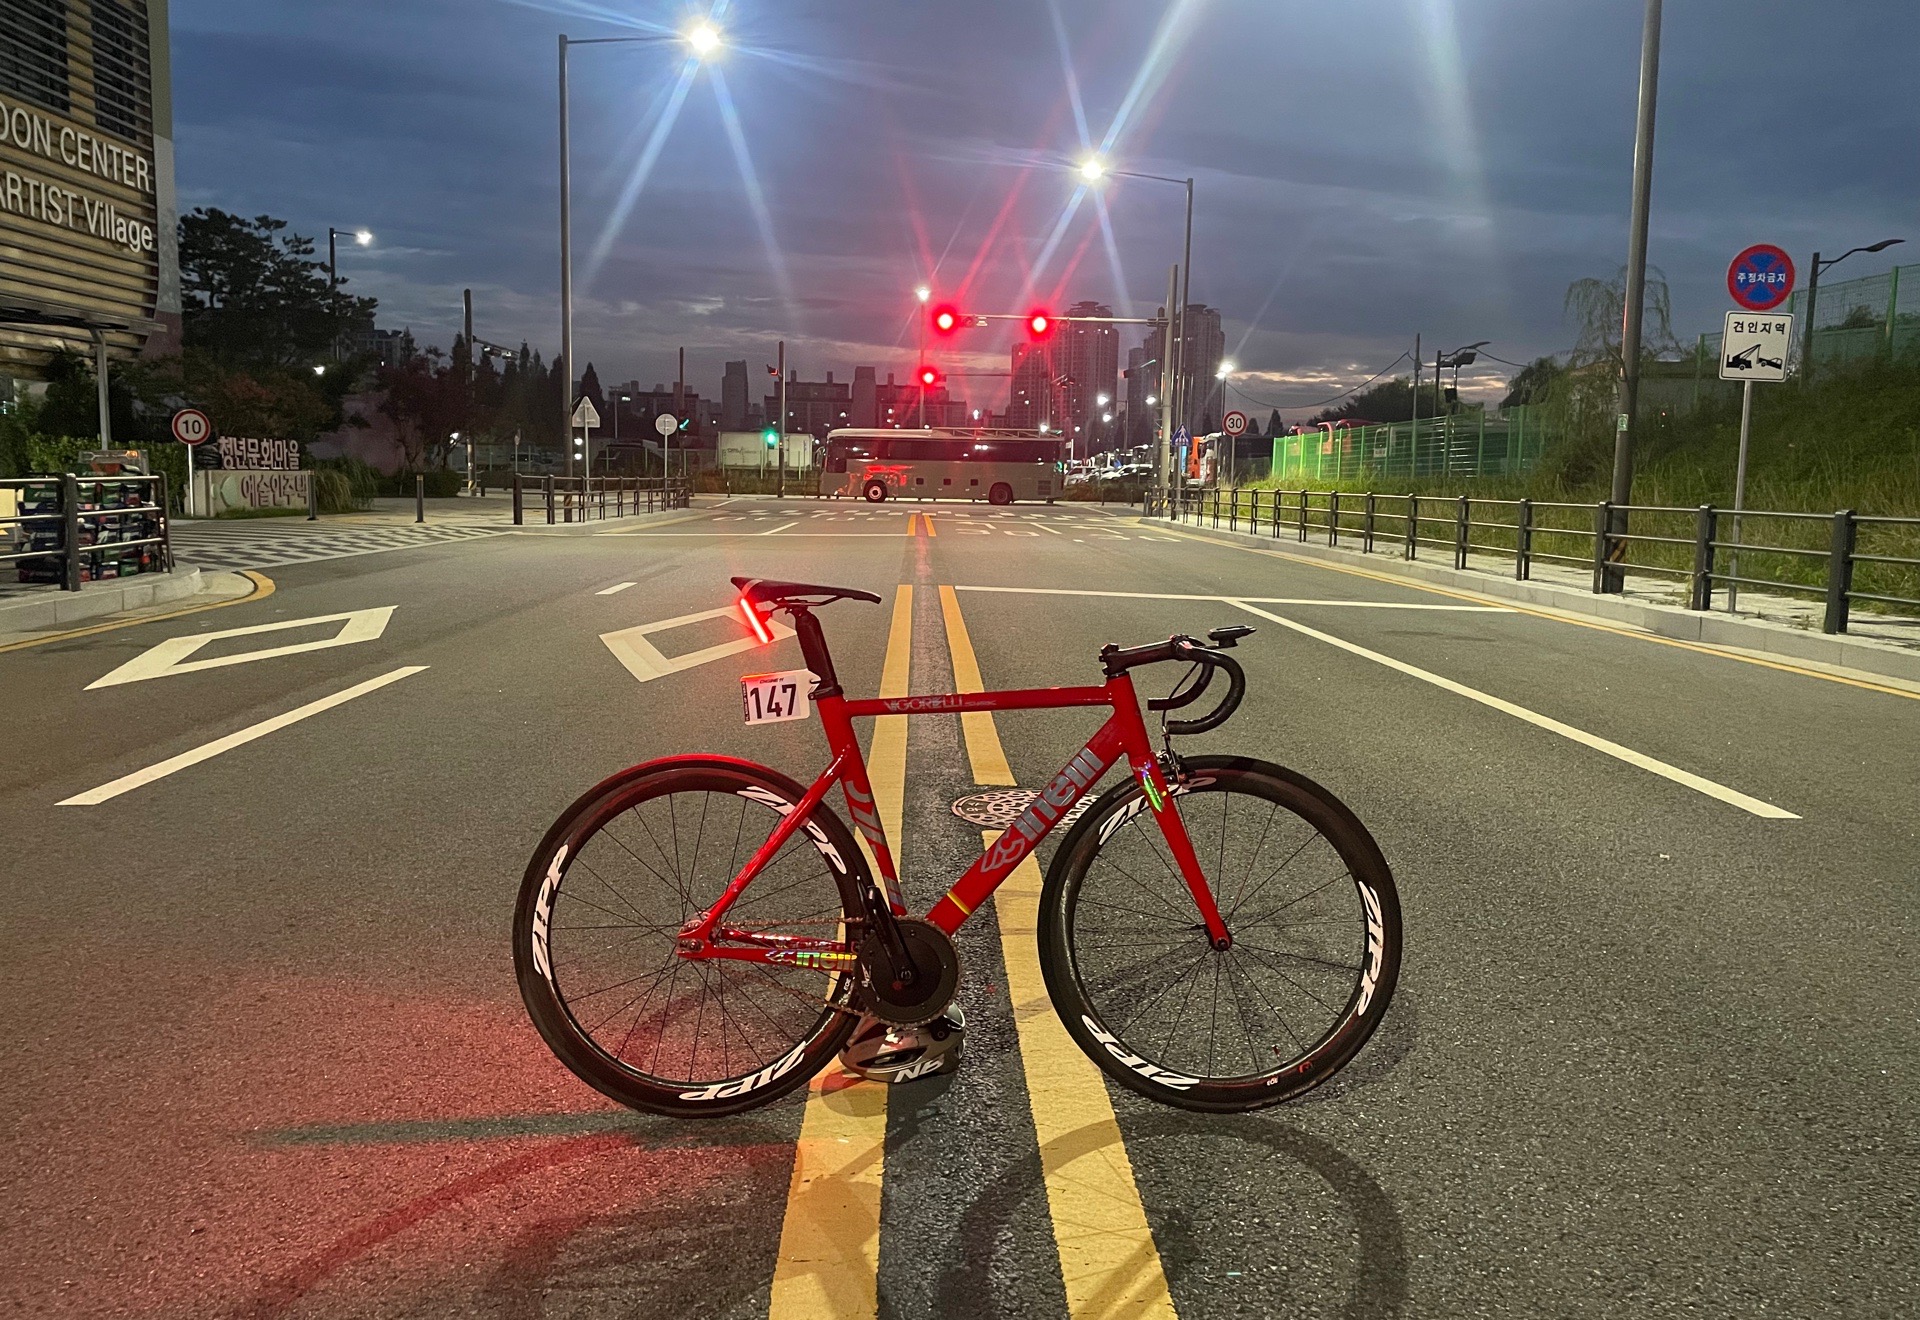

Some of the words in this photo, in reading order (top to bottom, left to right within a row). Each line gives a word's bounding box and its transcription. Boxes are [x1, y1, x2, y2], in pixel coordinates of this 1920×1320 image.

[60, 126, 150, 193] CENTER
[83, 196, 153, 253] Village
[1737, 272, 1786, 283] 주정차금지
[1733, 321, 1786, 335] 견인지역
[182, 419, 202, 435] 10
[1227, 417, 1243, 429] 30
[218, 436, 300, 470] 청년문화마을
[240, 474, 308, 508] 예술인주택
[749, 683, 796, 719] 147
[532, 844, 569, 981] ZIPP
[1358, 880, 1384, 1017] ZIPP
[678, 1040, 807, 1101] ZIPP
[1081, 1014, 1200, 1091] ZIPP
